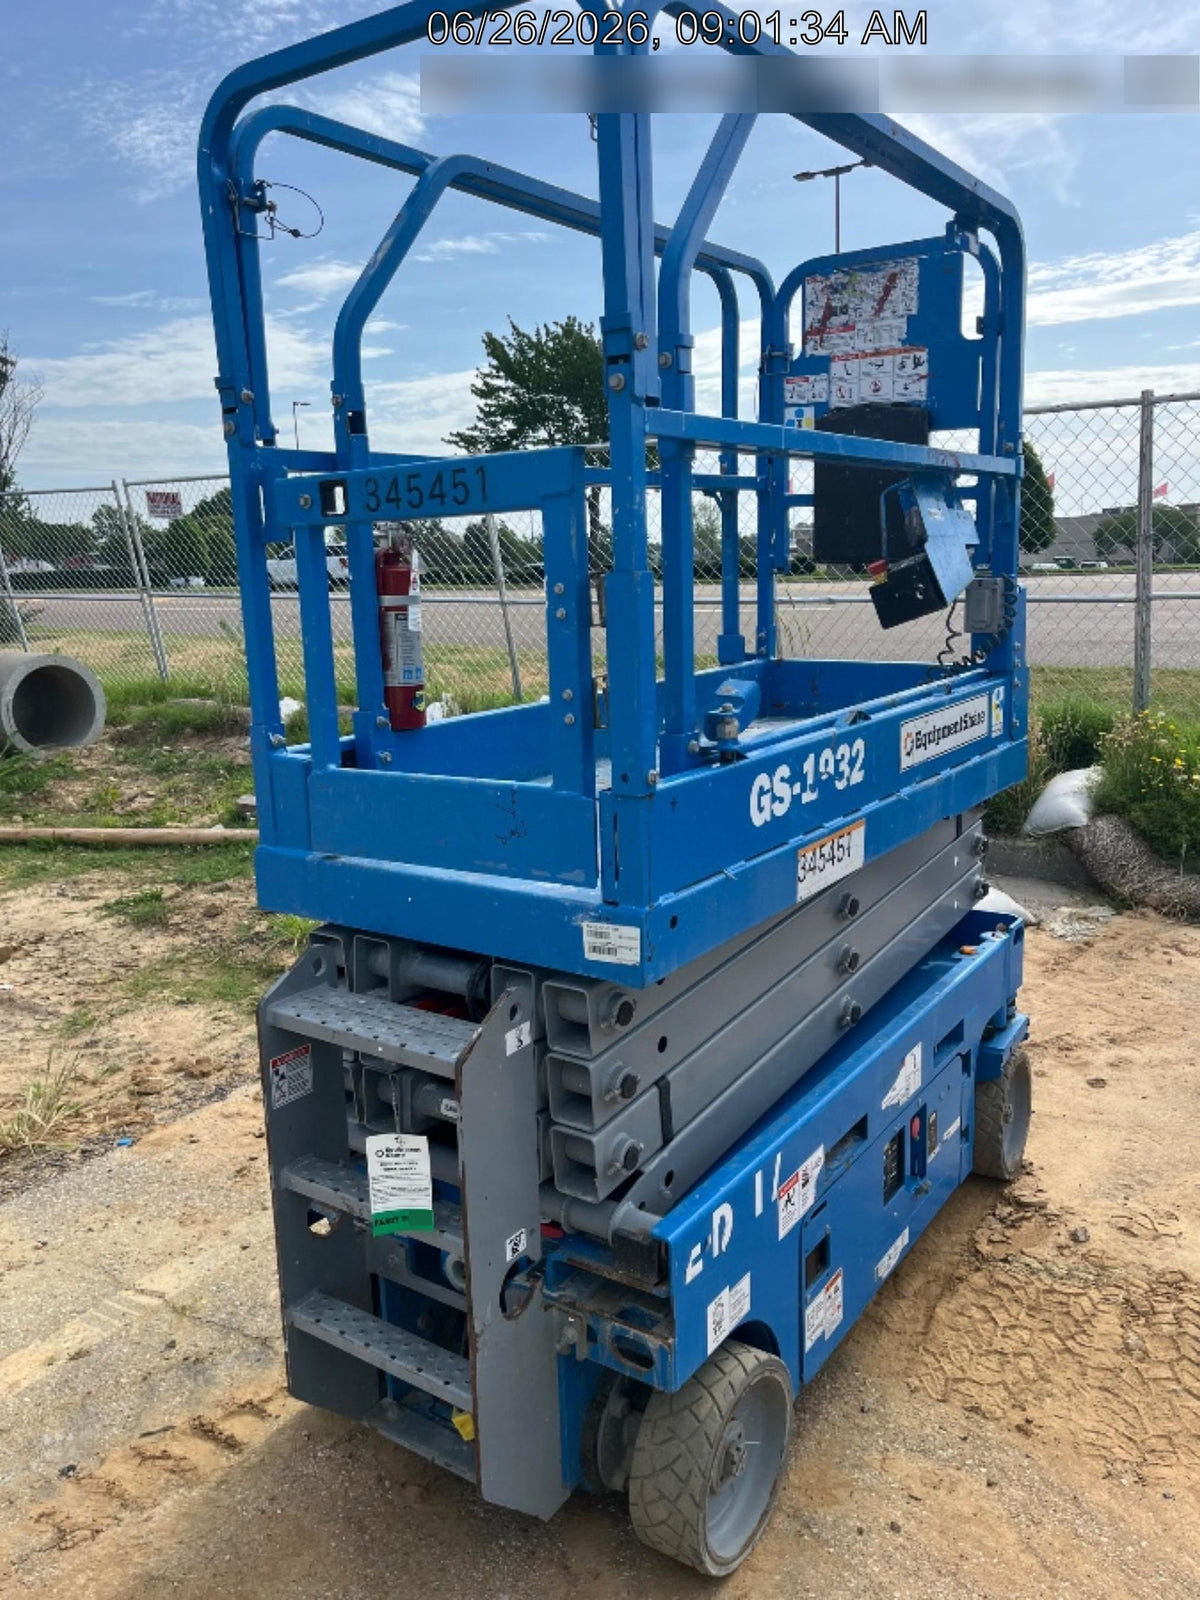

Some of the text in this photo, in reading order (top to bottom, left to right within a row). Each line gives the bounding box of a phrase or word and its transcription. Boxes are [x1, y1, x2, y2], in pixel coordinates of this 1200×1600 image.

[364, 466, 488, 512] 345451
[914, 710, 986, 750] EquipmentShare
[750, 738, 865, 827] GS-1932
